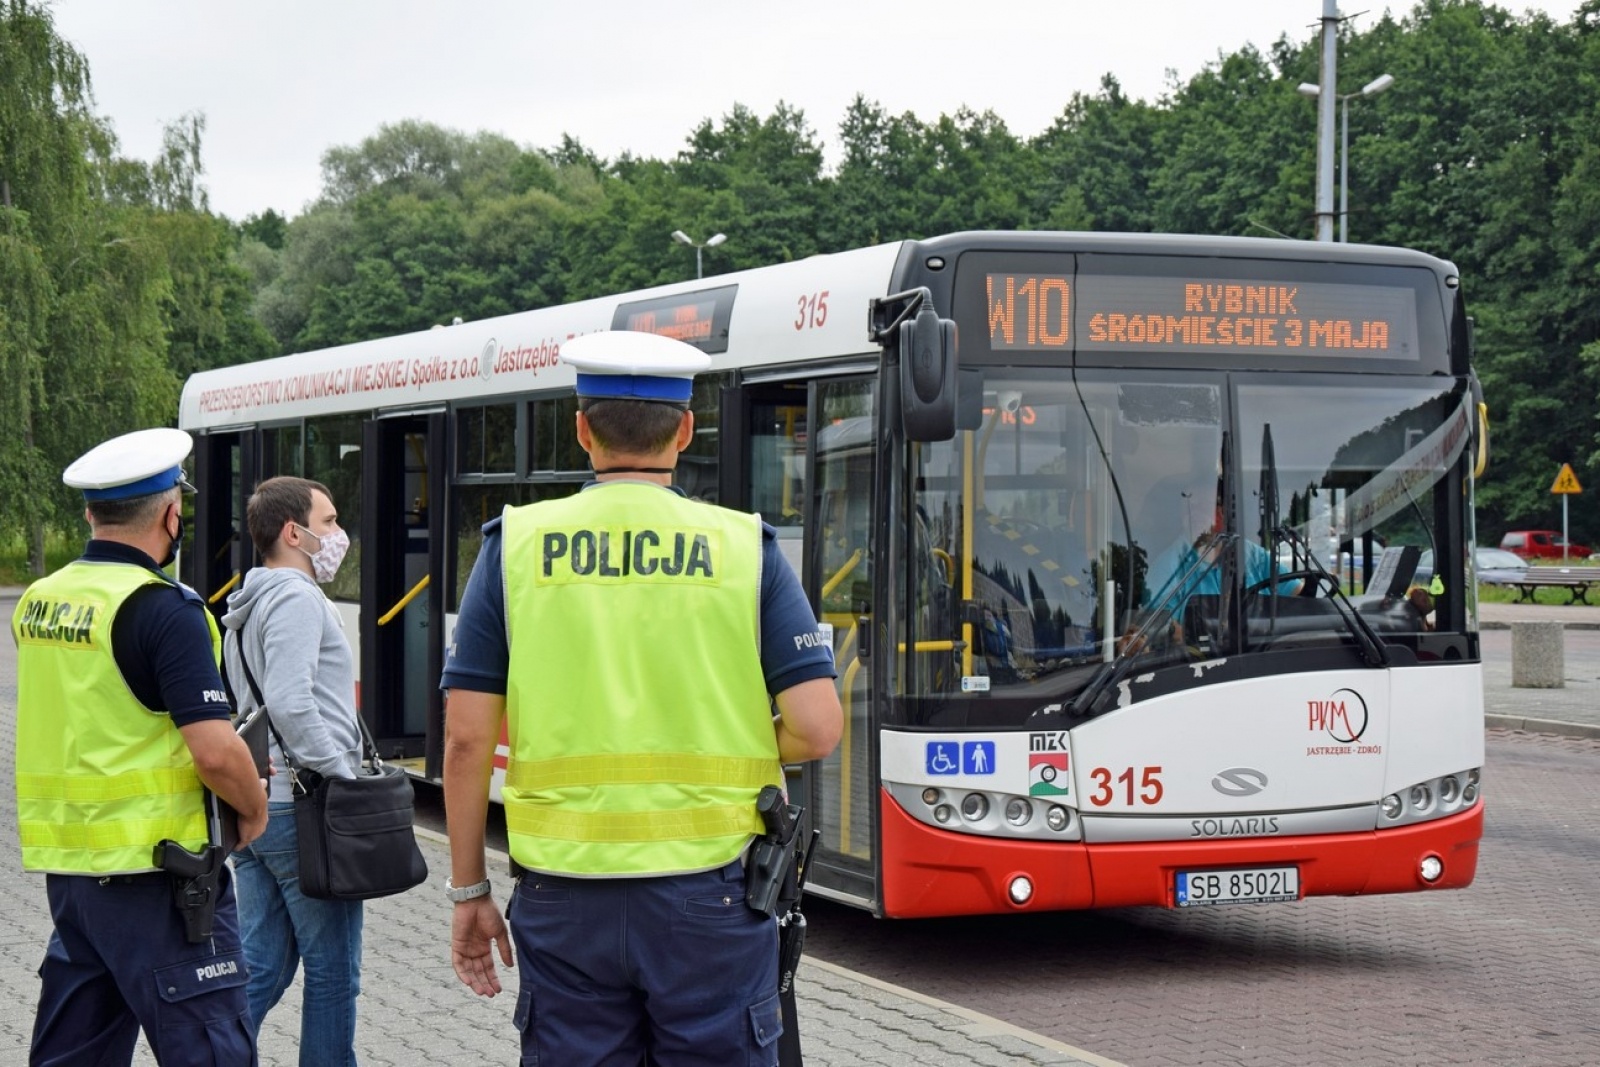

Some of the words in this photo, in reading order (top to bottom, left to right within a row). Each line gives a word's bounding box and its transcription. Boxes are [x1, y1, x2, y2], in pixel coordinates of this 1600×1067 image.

[795, 290, 830, 331] 315
[986, 276, 1069, 346] W10
[1185, 283, 1297, 315] RYBNIK
[1089, 312, 1278, 347] ŚRÓDMIEŚCIE
[1285, 319, 1303, 347] 3
[1309, 319, 1389, 349] MAJA
[282, 368, 350, 402] KOMUNIKACJI
[352, 357, 409, 393] MIEJSKIEJ
[411, 356, 447, 390] Spółka
[450, 362, 457, 380] z
[460, 356, 480, 376] o.o.
[494, 337, 559, 376] Jastrzębie
[543, 529, 713, 577] POLICJA
[20, 599, 96, 644] POLICJA
[1029, 732, 1067, 751] MZK
[1306, 746, 1352, 757] JASTRZĘBIE
[1357, 744, 1382, 755] ZDRÓJ
[1089, 766, 1164, 807] 315
[1191, 817, 1279, 837] SOLARIS
[1191, 875, 1222, 899] SB
[1229, 871, 1295, 897] 8502L
[196, 960, 238, 982] POLICJA
